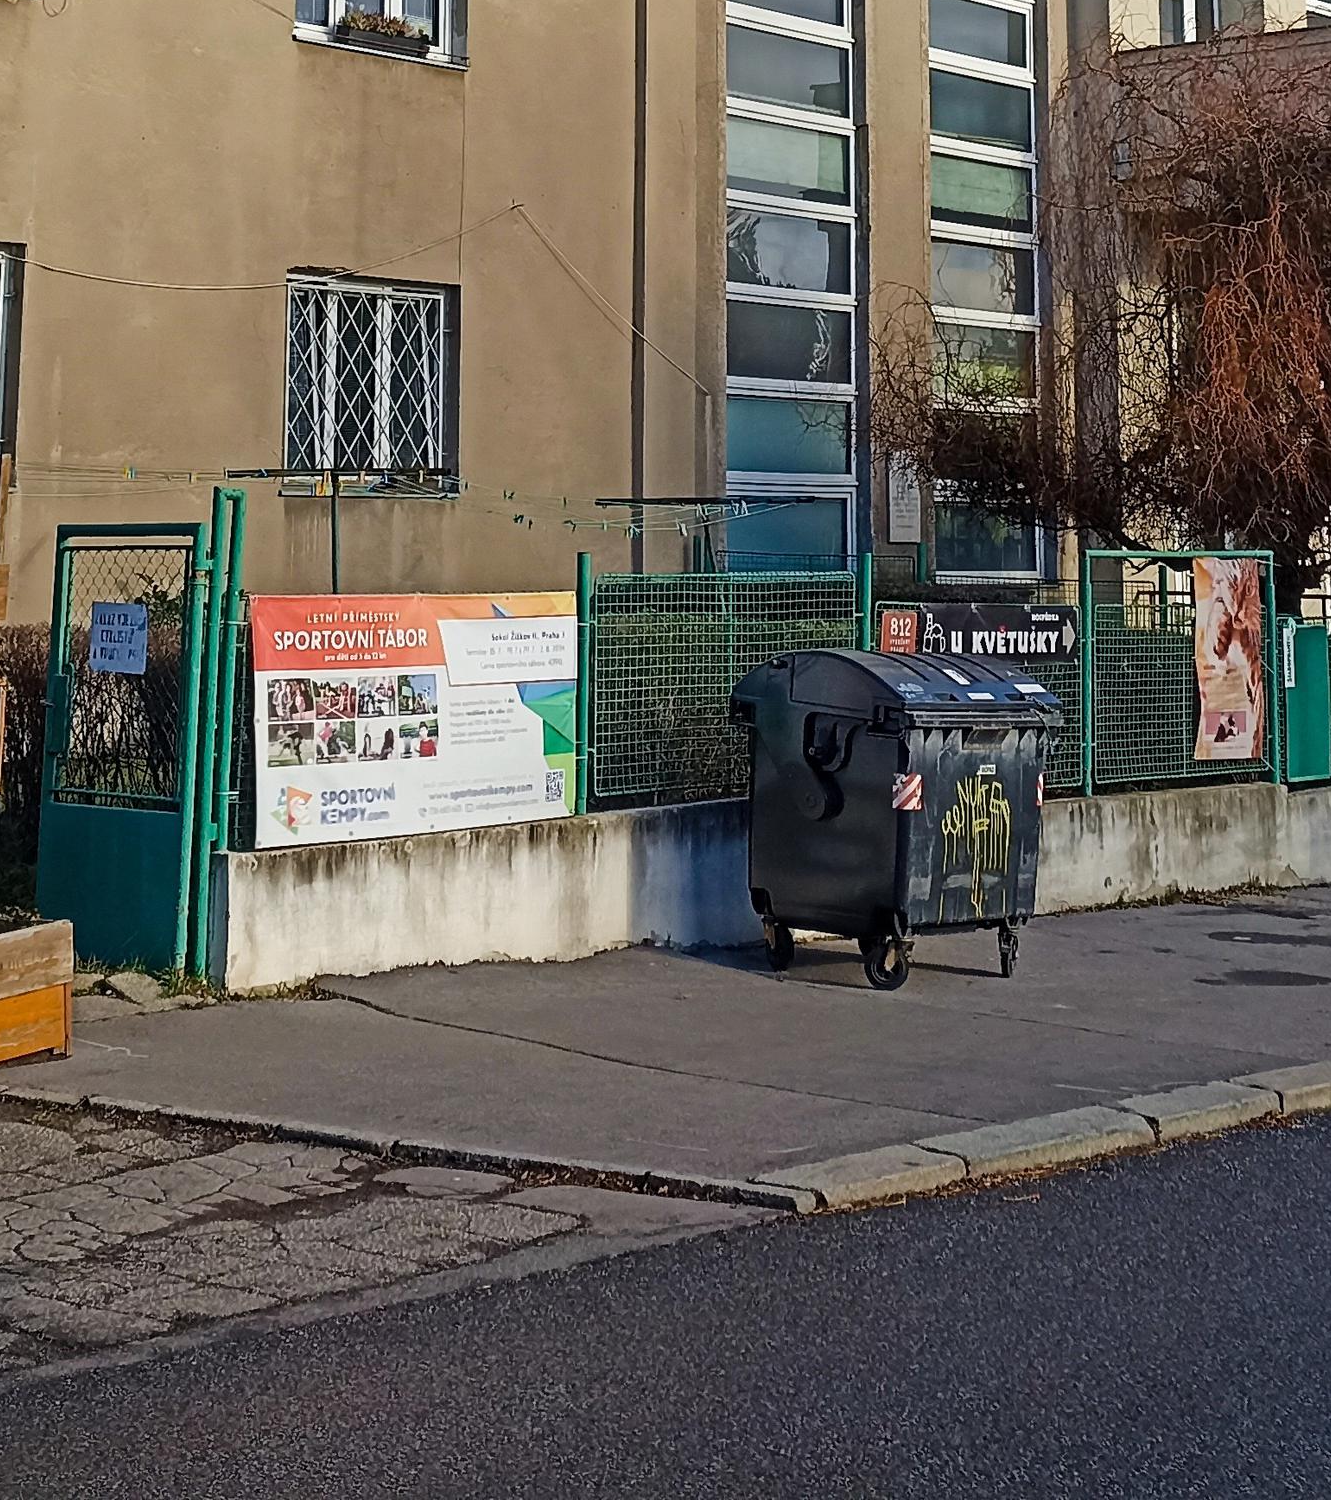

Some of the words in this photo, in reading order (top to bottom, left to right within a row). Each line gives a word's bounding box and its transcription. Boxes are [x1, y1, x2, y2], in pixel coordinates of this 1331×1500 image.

[307, 611, 338, 624] LETNÍ
[342, 610, 400, 624] PŘÍMĚSTSKÝ
[890, 617, 912, 637] 812
[273, 624, 375, 651] SPORTOVNÍ
[377, 623, 428, 649] TÁBOR
[491, 633, 509, 641] Sokol
[541, 631, 560, 640] Praha
[950, 630, 963, 654] U
[320, 782, 395, 806] SPORTOVNÍ
